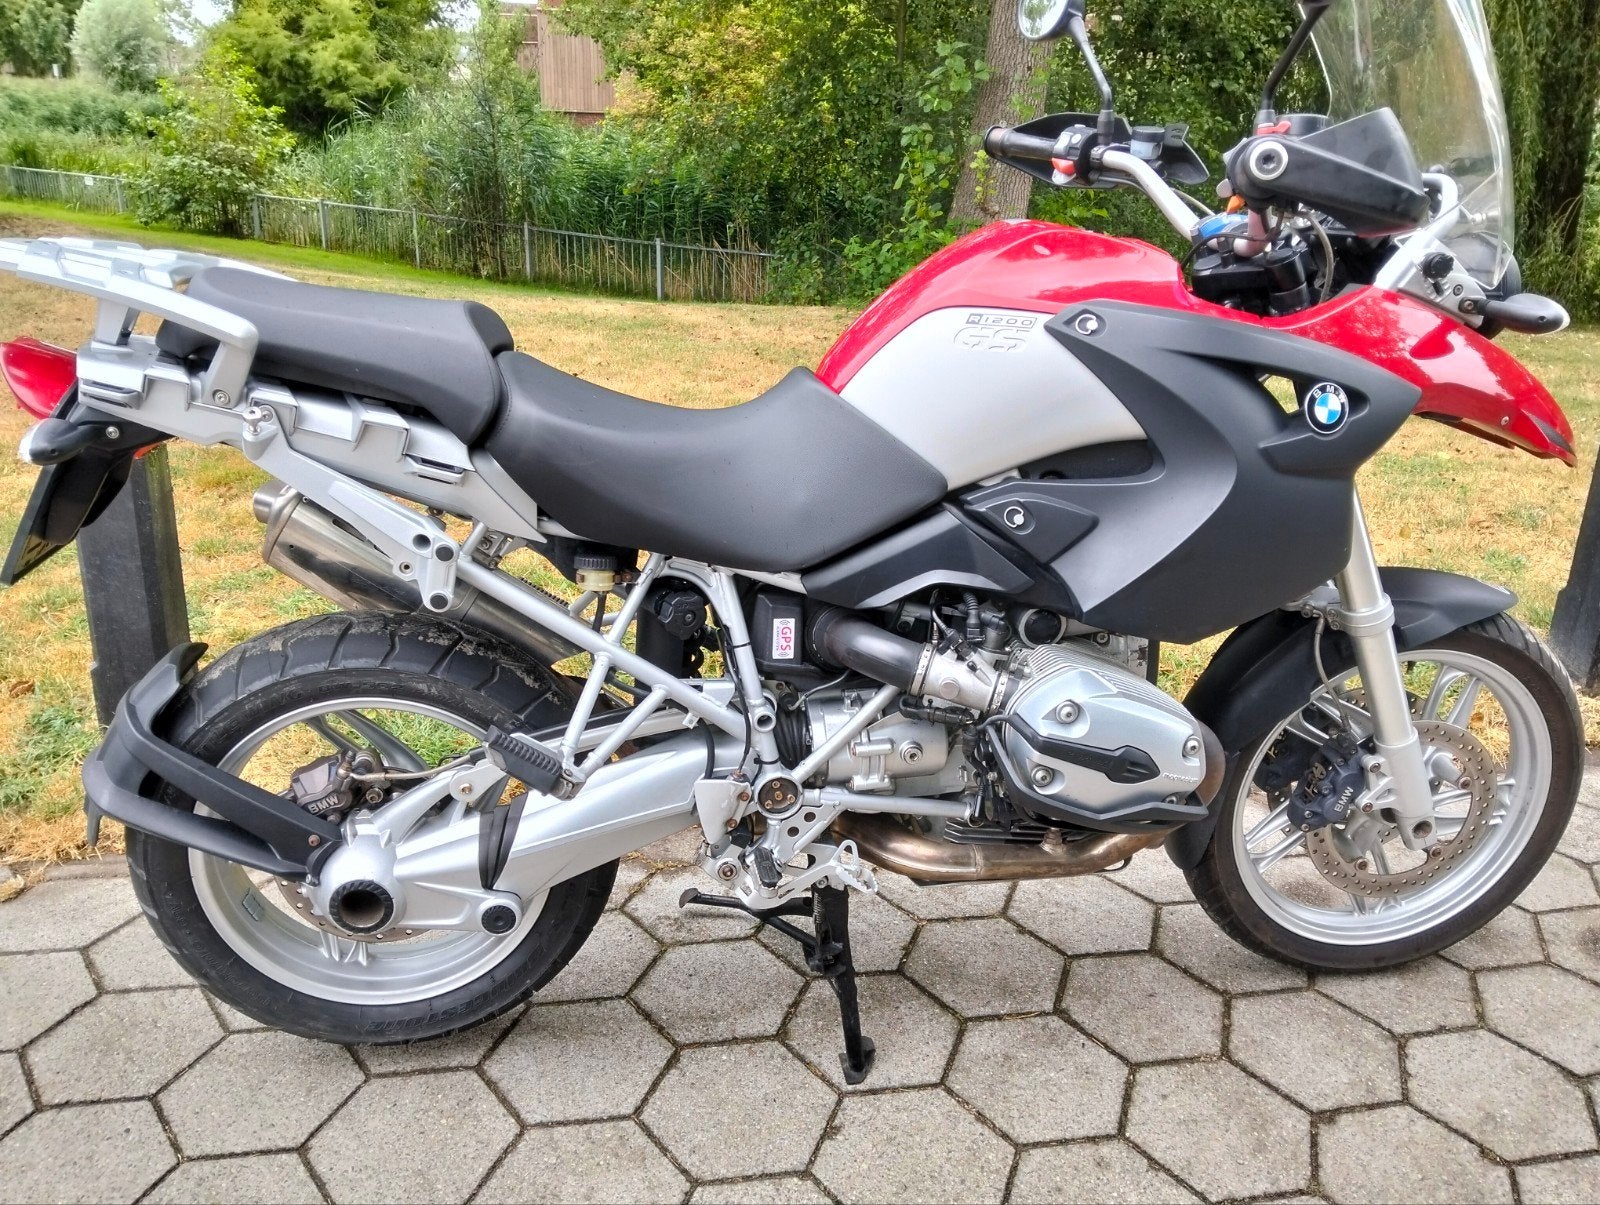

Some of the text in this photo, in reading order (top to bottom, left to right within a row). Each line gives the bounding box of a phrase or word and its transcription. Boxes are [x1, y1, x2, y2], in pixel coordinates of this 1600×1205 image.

[966, 313, 1034, 327] R1200
[953, 326, 1030, 352] GS
[781, 626, 792, 652] GPS
[308, 794, 339, 814] BMW
[1334, 786, 1354, 812] BMW
